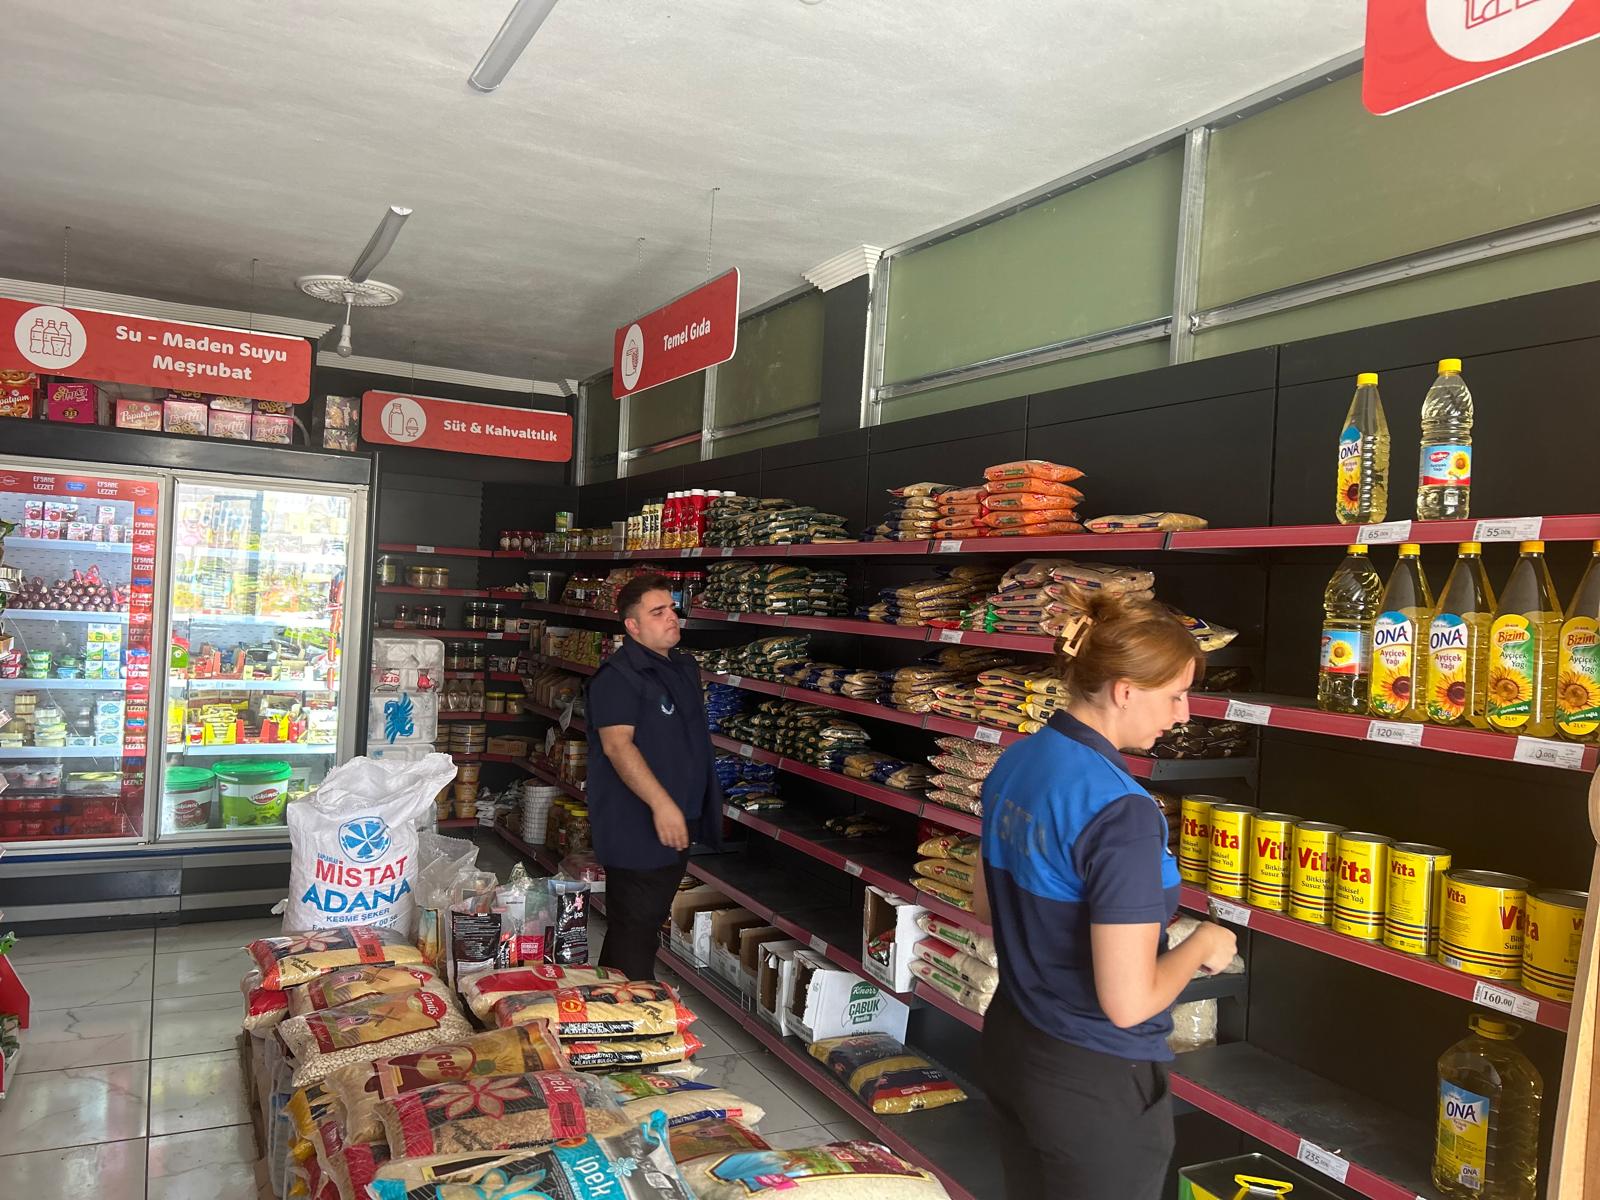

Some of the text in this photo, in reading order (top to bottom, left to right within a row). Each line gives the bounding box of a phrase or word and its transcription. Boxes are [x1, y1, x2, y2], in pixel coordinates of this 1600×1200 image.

[664, 316, 710, 352] Temel Gıda
[116, 325, 142, 342] Su
[162, 331, 233, 354] Maden
[239, 342, 287, 364] Suyu
[152, 354, 252, 381] Meşrubat
[443, 419, 557, 442] Süt & Kahvaltılık
[1340, 442, 1359, 460] ONA
[1375, 626, 1408, 645] ONA
[1430, 628, 1464, 649] ONA
[1498, 631, 1525, 642] Bizim
[1567, 634, 1595, 646] Bizim
[1380, 649, 1406, 658] Ayçiçek
[1435, 654, 1462, 662] Ayçiçek
[1500, 651, 1528, 660] Ayçiçek
[1569, 655, 1597, 664] Ayçiçek
[315, 856, 408, 888] MİSTAT
[1392, 861, 1415, 877] Vita
[301, 878, 411, 914] ADANA
[1447, 887, 1466, 904] Vita
[327, 908, 390, 923] KESME ŞEKER
[853, 986, 877, 994] Knorr
[1482, 990, 1512, 1007] 160.00
[849, 999, 880, 1019] ÇABUK
[1447, 1101, 1476, 1122] ONA
[574, 1155, 614, 1197] ipek
[1463, 1168, 1477, 1176] ONA
